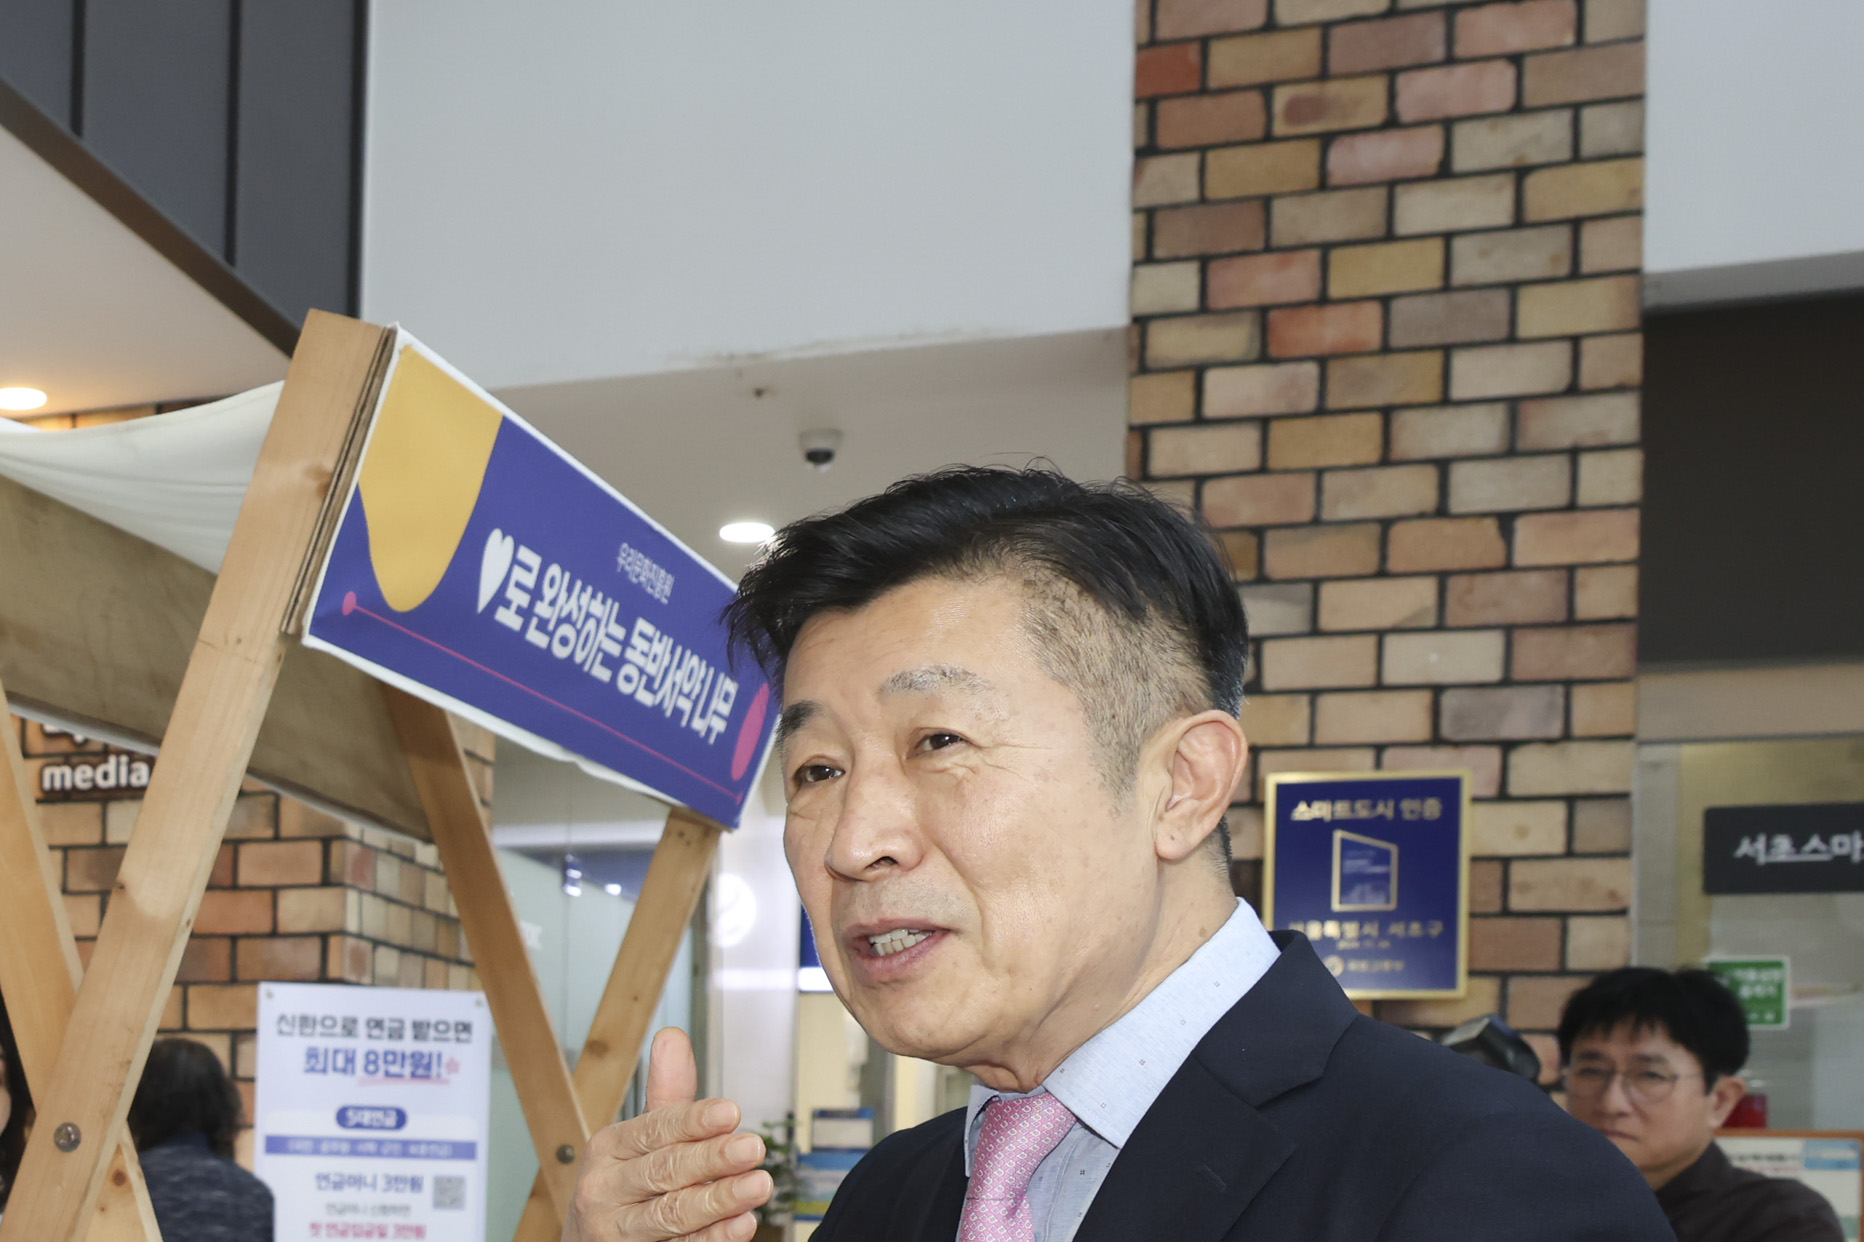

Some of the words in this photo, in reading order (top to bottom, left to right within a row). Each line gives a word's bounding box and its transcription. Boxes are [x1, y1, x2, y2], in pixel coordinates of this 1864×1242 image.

[494, 545, 542, 632] 로
[525, 563, 626, 683] 완성하는
[41, 754, 150, 792] media
[1734, 831, 1864, 866] 서초스마
[277, 1014, 359, 1038] 신한으로
[366, 1017, 405, 1041] 연금
[413, 1020, 473, 1043] 받으면
[304, 1047, 356, 1075] 최대
[363, 1050, 442, 1079] 8만원!
[382, 1174, 424, 1193] 3만원
